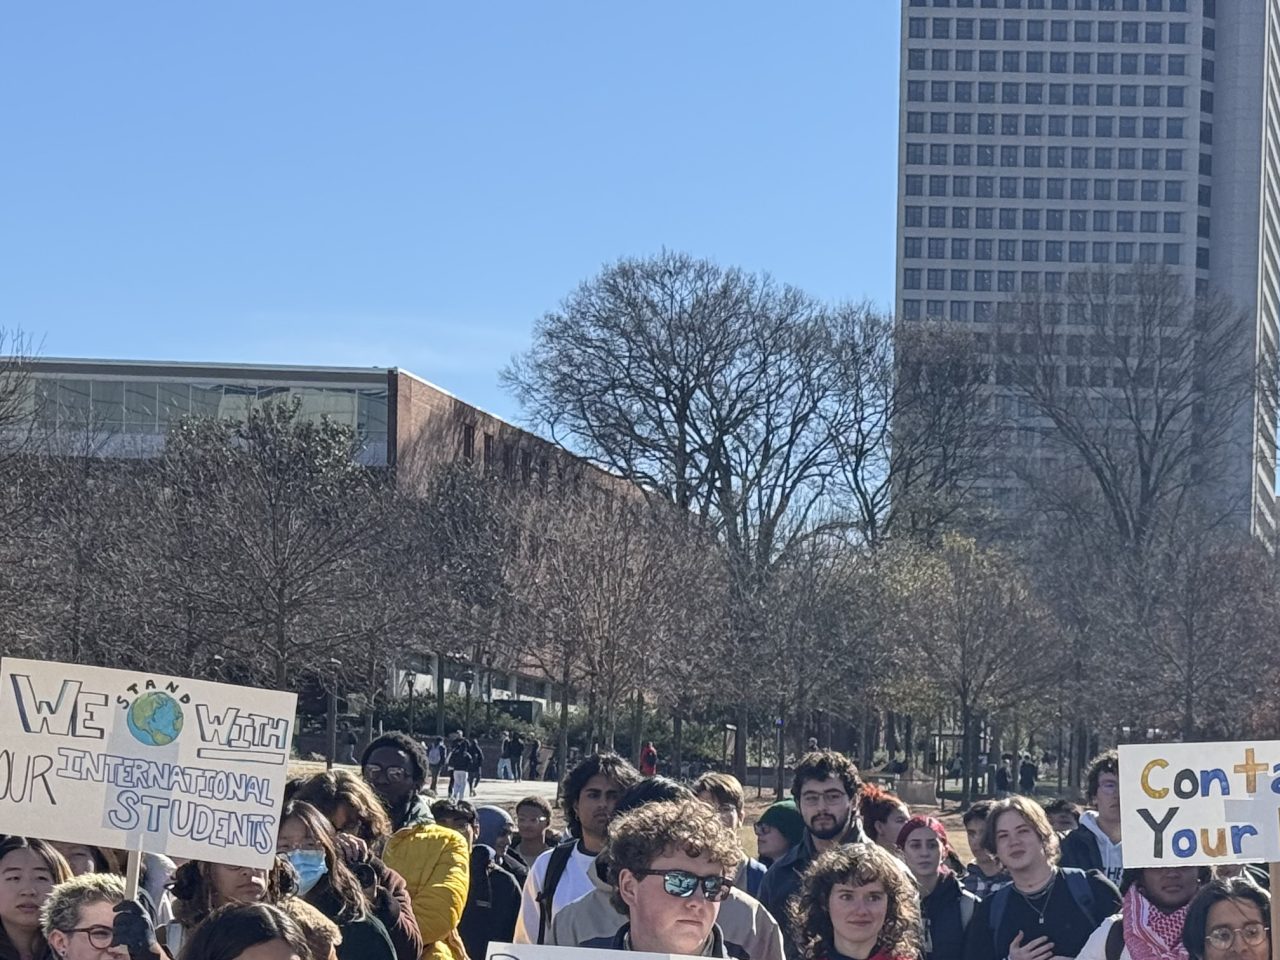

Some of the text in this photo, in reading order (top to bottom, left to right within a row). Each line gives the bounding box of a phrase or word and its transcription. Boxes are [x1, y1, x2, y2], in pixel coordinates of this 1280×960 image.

[10, 673, 289, 749] WE STAND WITH
[56, 747, 274, 806] INTERNATIONAL
[108, 791, 276, 854] STUDENTS
[1136, 806, 1258, 858] Your
